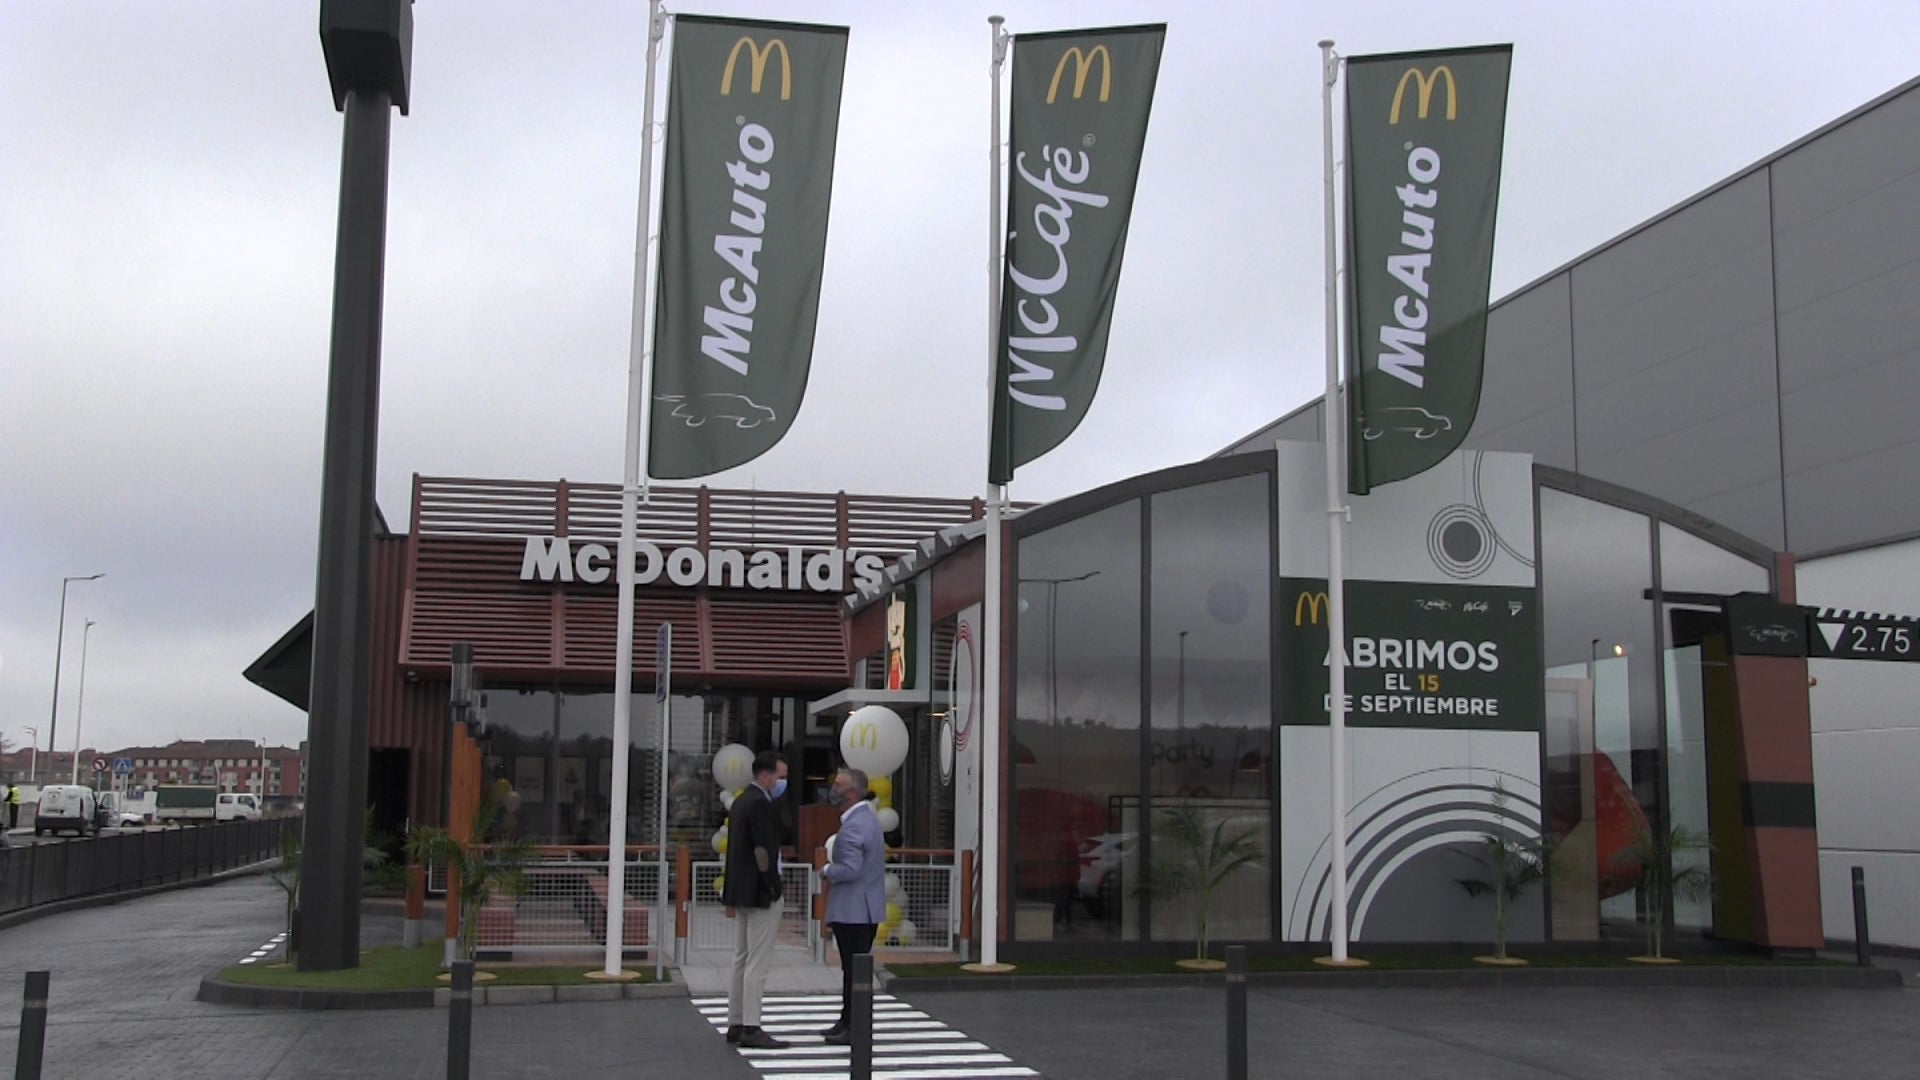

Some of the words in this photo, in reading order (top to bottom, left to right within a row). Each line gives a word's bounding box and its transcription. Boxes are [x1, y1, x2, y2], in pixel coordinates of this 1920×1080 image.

[700, 122, 775, 376] McAuto
[1377, 146, 1441, 389] McAuto
[519, 536, 885, 593] McDonald's
[1851, 625, 1911, 654] 2.75
[1385, 673, 1411, 691] EL
[1417, 674, 1440, 692] 15
[1360, 694, 1499, 717] SEPTIEMBRE
